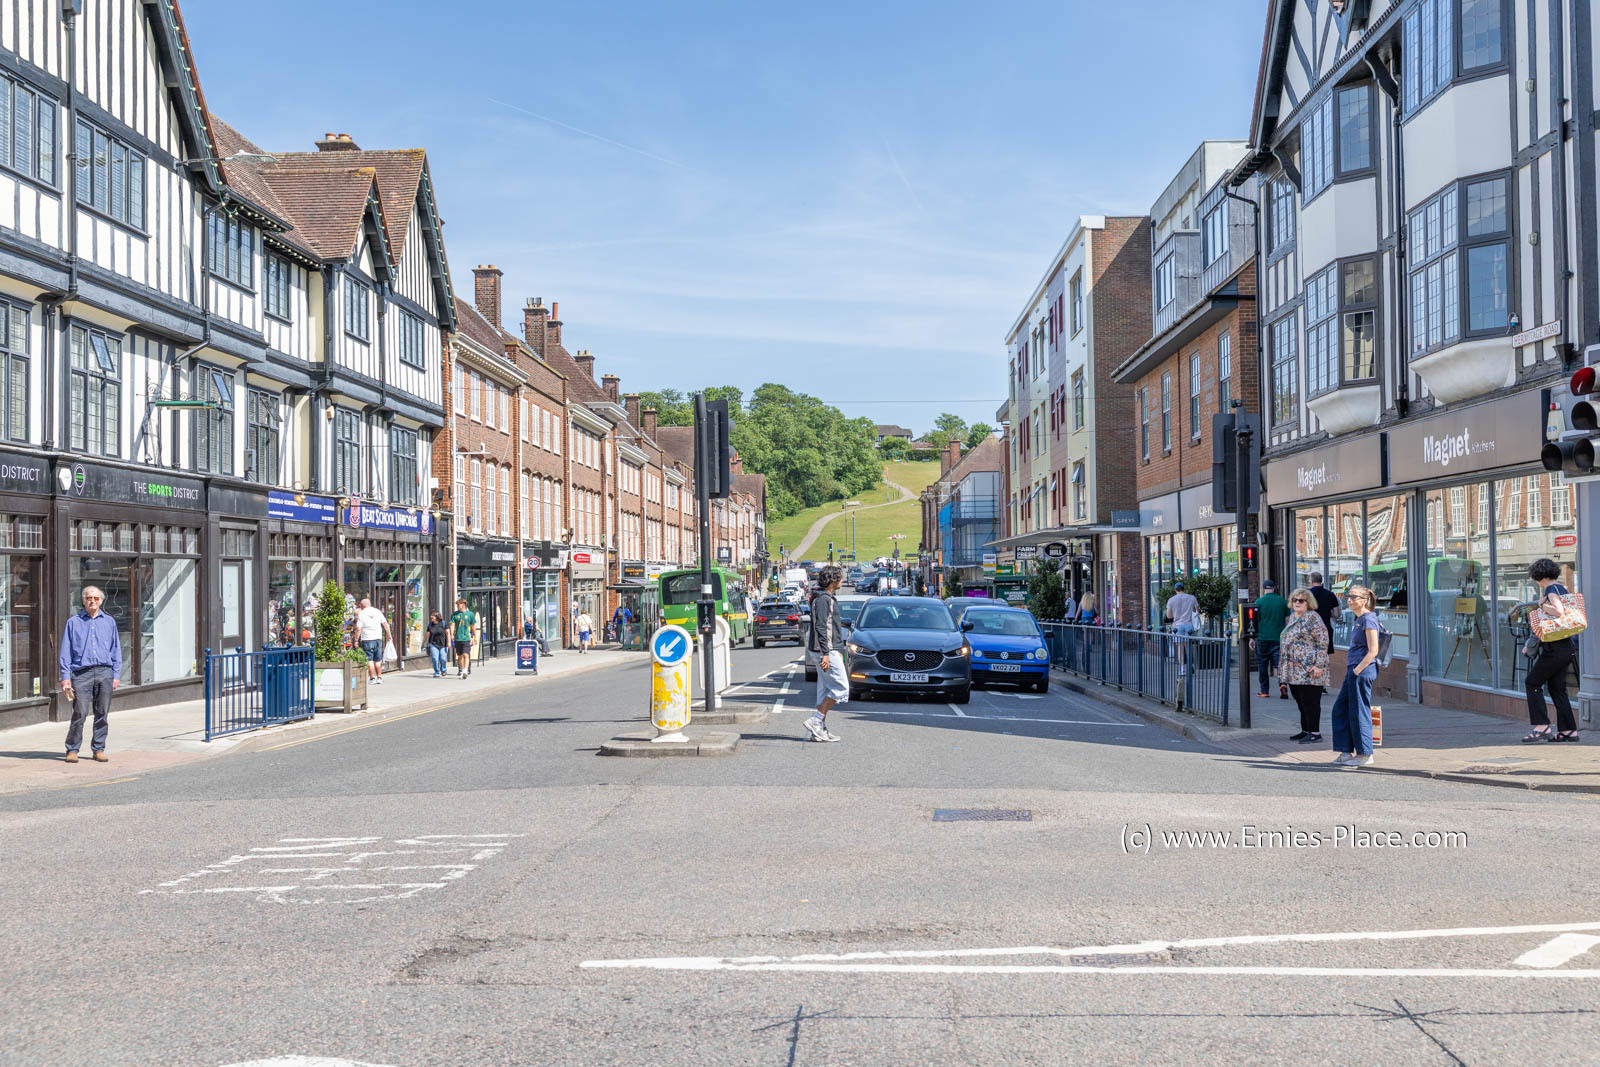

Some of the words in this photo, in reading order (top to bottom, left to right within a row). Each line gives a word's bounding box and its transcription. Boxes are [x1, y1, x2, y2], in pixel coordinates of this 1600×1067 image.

[1513, 327, 1543, 346] HERMITAGE
[1543, 322, 1559, 337] ROAD
[1423, 427, 1470, 466] Magnet
[1, 464, 41, 482] DISTRICT
[1297, 461, 1326, 491] Magnet
[133, 481, 147, 494] THE
[147, 483, 173, 497] SPORTS
[173, 486, 199, 500] DISTRICT
[361, 506, 375, 523] BEAT
[375, 508, 395, 526] SCHOOL
[1116, 517, 1136, 525] GREYS
[893, 672, 911, 681] LK23
[912, 673, 926, 681] KYE
